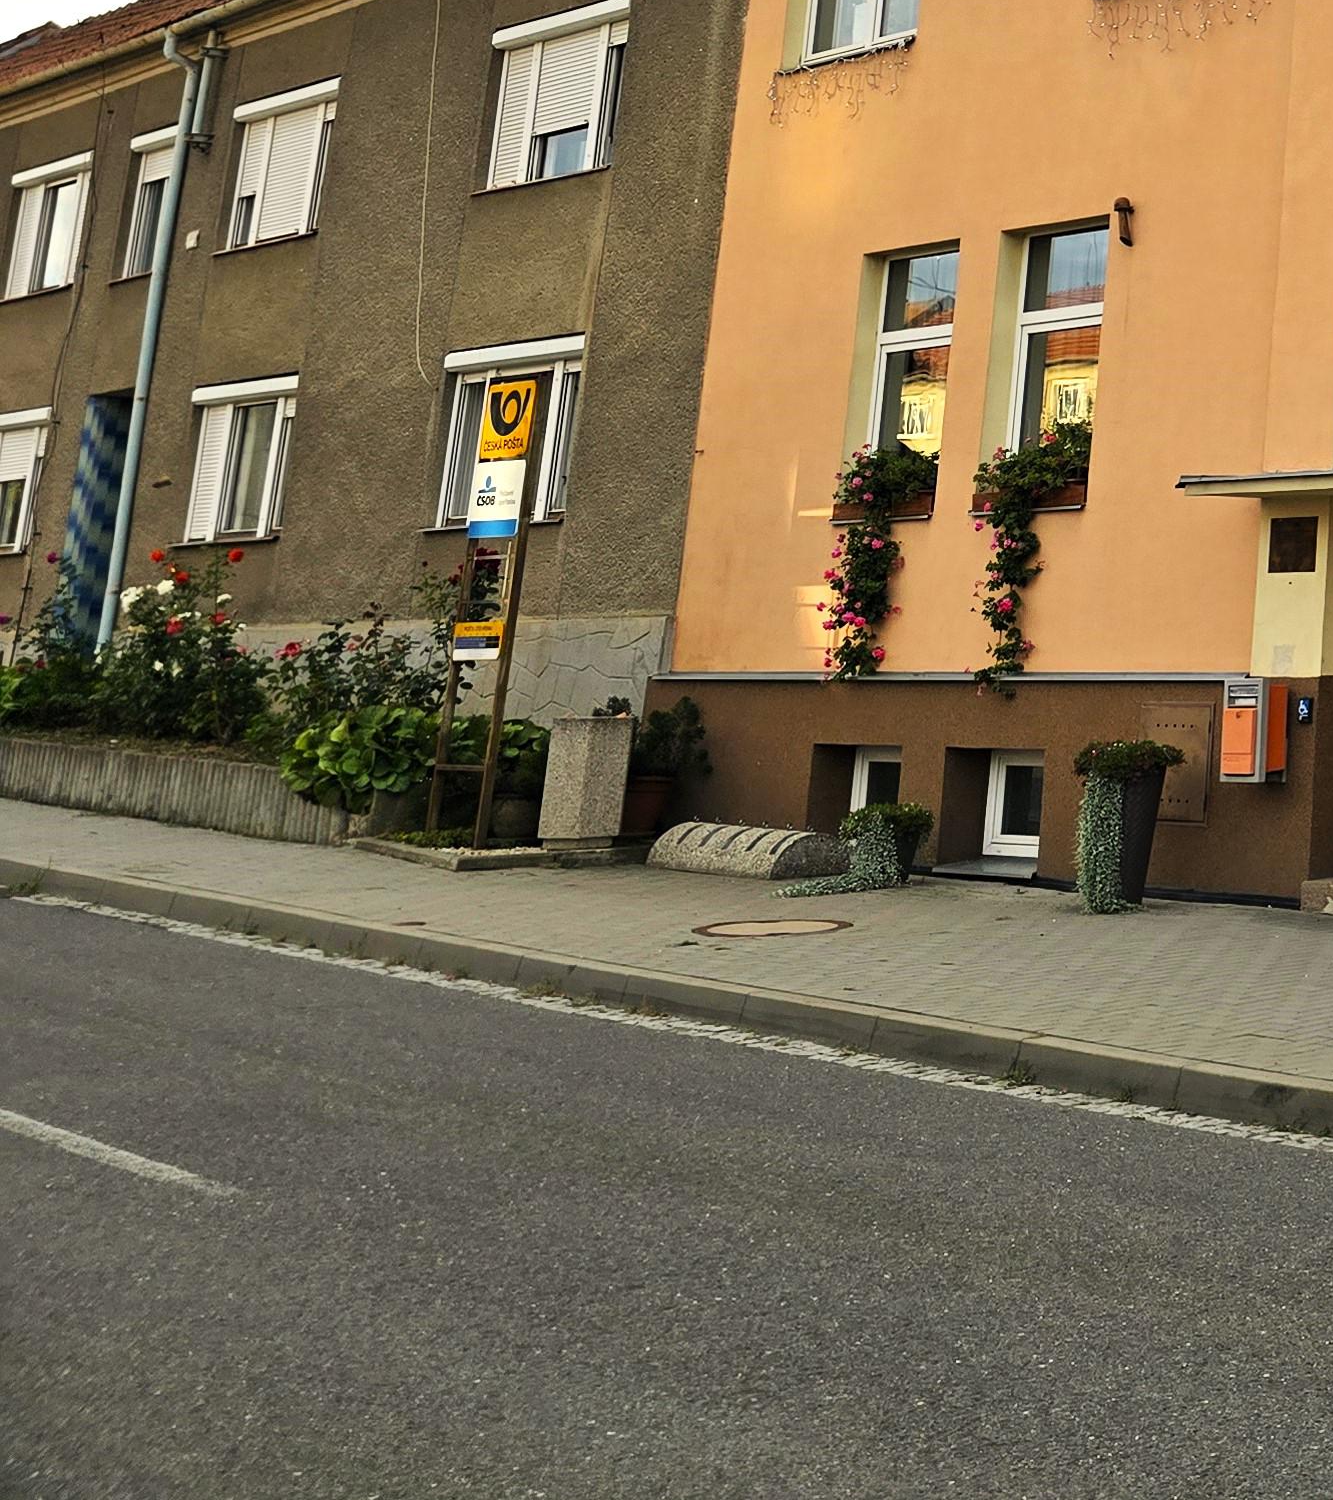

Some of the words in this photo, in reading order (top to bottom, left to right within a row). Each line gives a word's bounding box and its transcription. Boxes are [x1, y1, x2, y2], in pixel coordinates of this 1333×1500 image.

[483, 439, 502, 453] ČESKÁ
[503, 436, 525, 450] POŠTA
[476, 495, 496, 507] ČSOB
